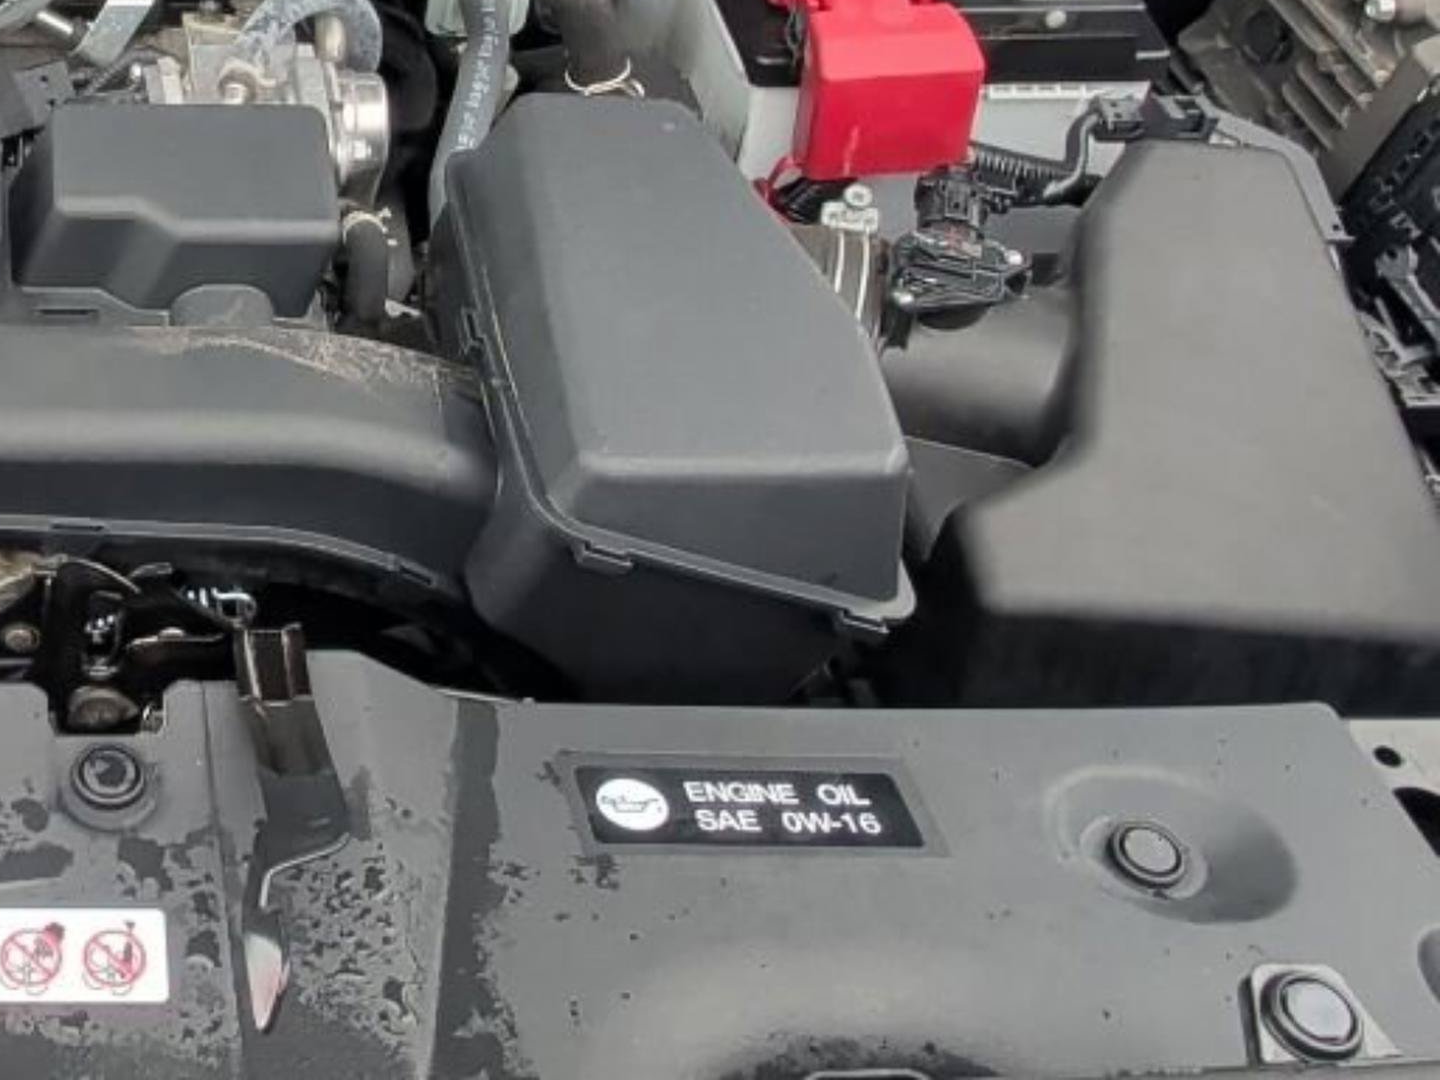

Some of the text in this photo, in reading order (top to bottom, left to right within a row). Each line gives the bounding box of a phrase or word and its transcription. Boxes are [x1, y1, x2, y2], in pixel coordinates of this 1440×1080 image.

[683, 781, 871, 806] ENGINE OIL
[694, 808, 882, 835] SAE 0W-16
